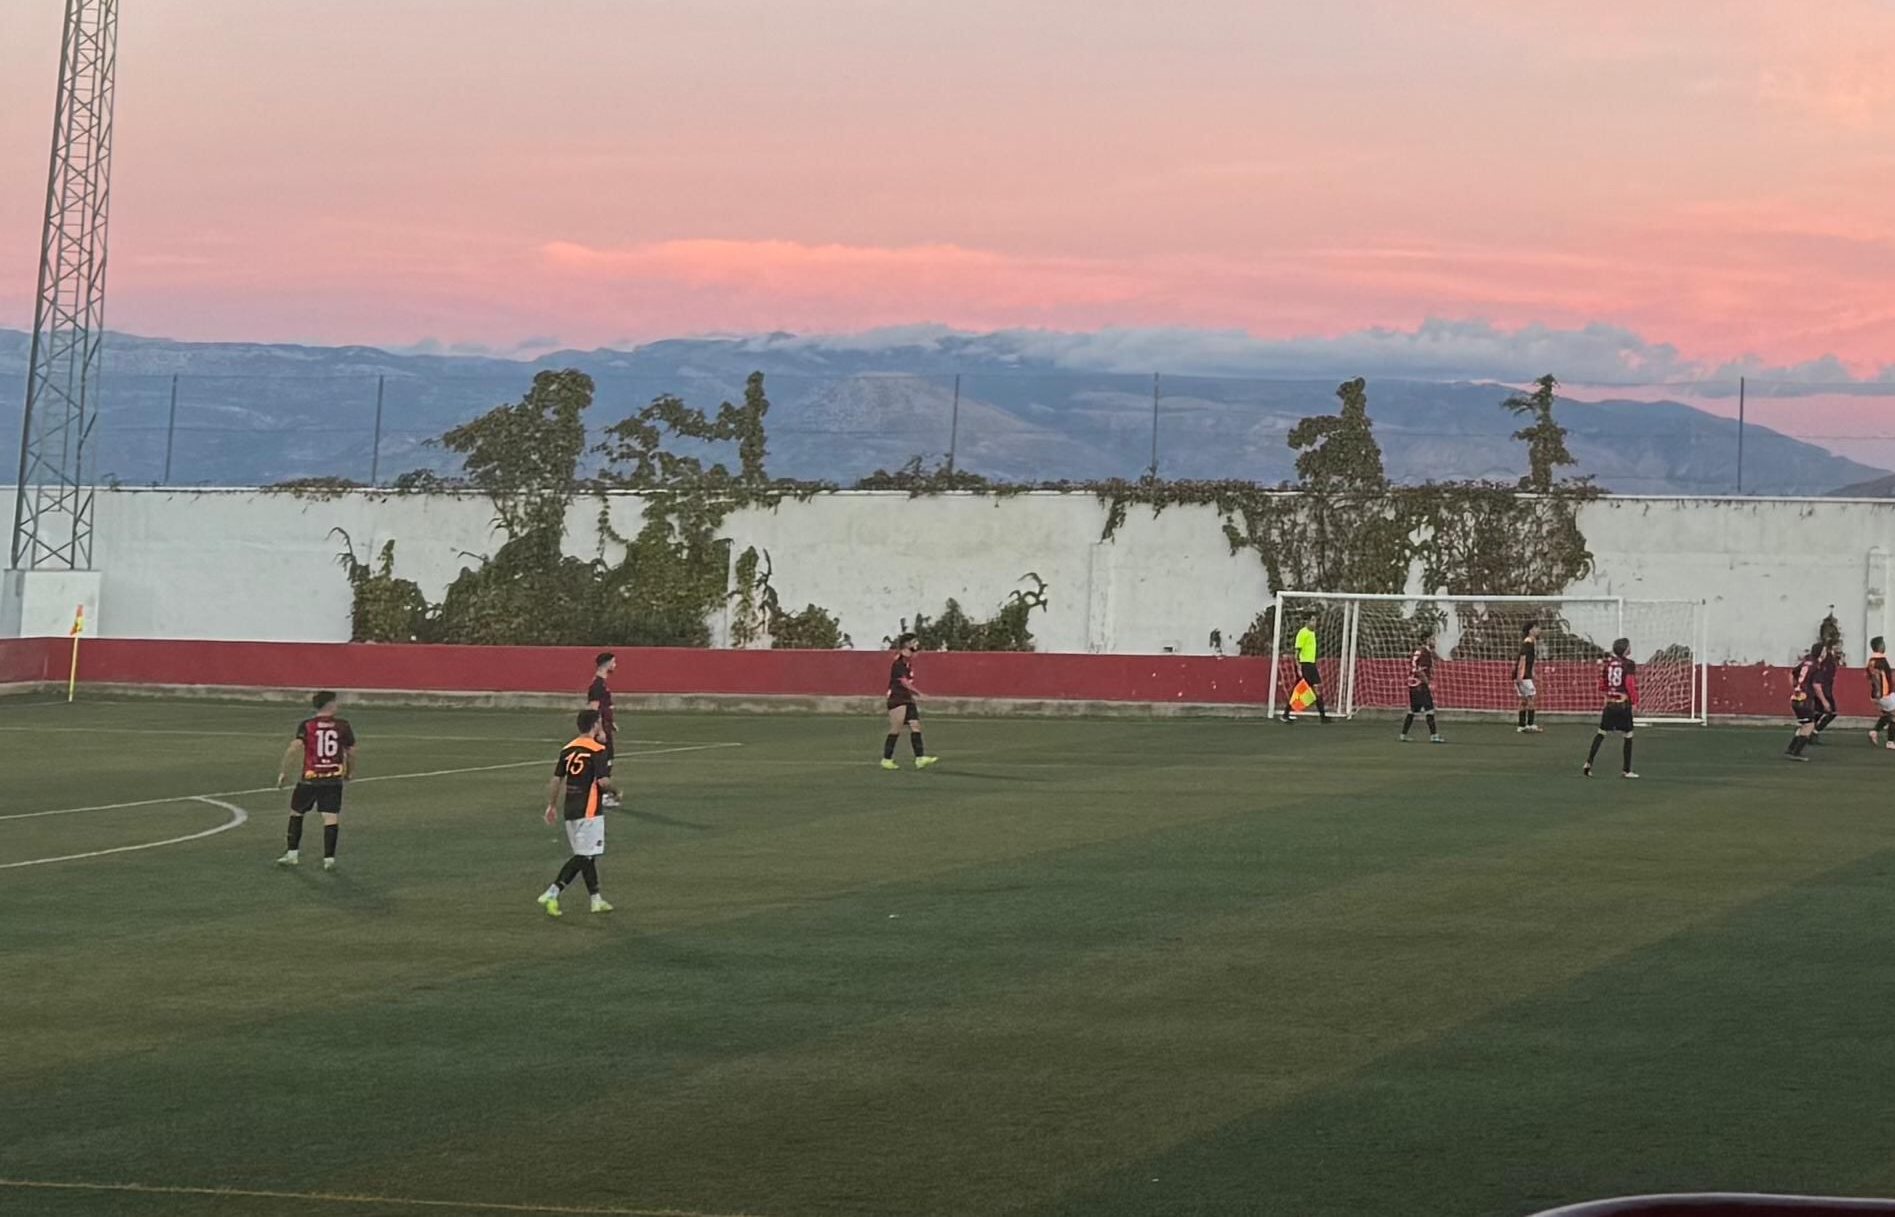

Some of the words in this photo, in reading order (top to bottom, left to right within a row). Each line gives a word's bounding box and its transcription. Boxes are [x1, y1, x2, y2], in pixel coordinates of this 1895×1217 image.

[1607, 665, 1623, 687] 18
[315, 729, 339, 758] 16
[564, 751, 592, 775] 15
